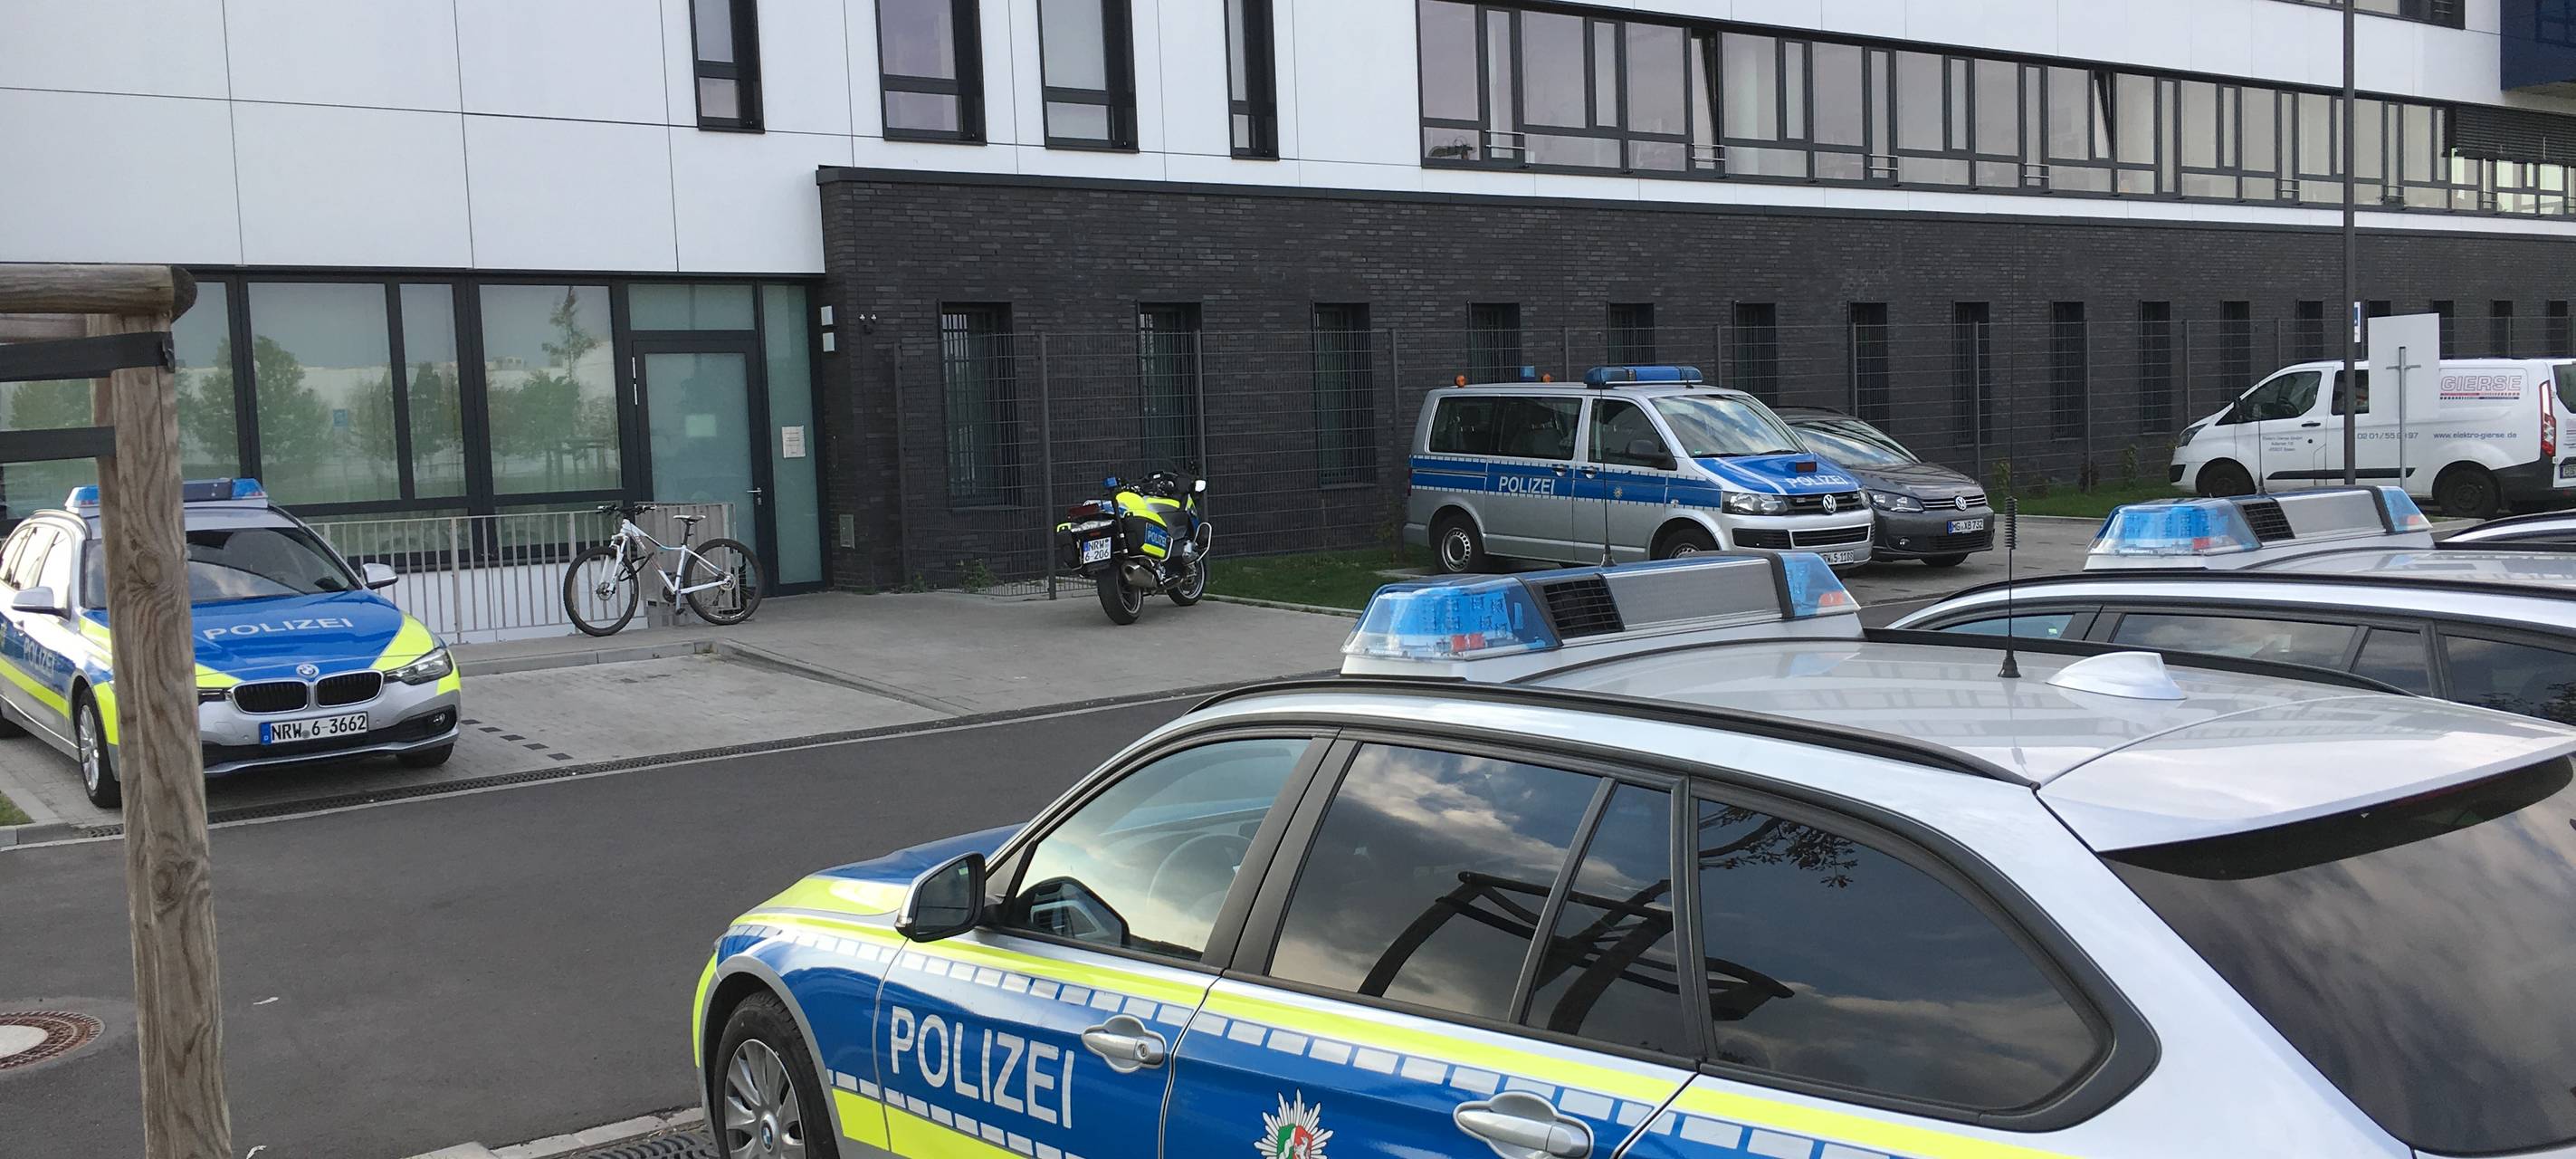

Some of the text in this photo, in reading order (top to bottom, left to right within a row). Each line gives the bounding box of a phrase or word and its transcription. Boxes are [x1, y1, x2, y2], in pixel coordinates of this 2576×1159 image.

[2440, 376, 2522, 391] GIERSE
[1498, 475, 1556, 494] POLIZEI
[1785, 474, 1848, 488] POLIZEI
[1085, 549, 1110, 561] 6-206
[1089, 540, 1104, 551] NRW
[203, 618, 353, 640] POLIZEI
[24, 637, 55, 679] POLIZEI
[272, 723, 302, 741] NRW
[311, 714, 367, 736] 6-3662
[890, 1005, 1076, 1129] POLIZEI
